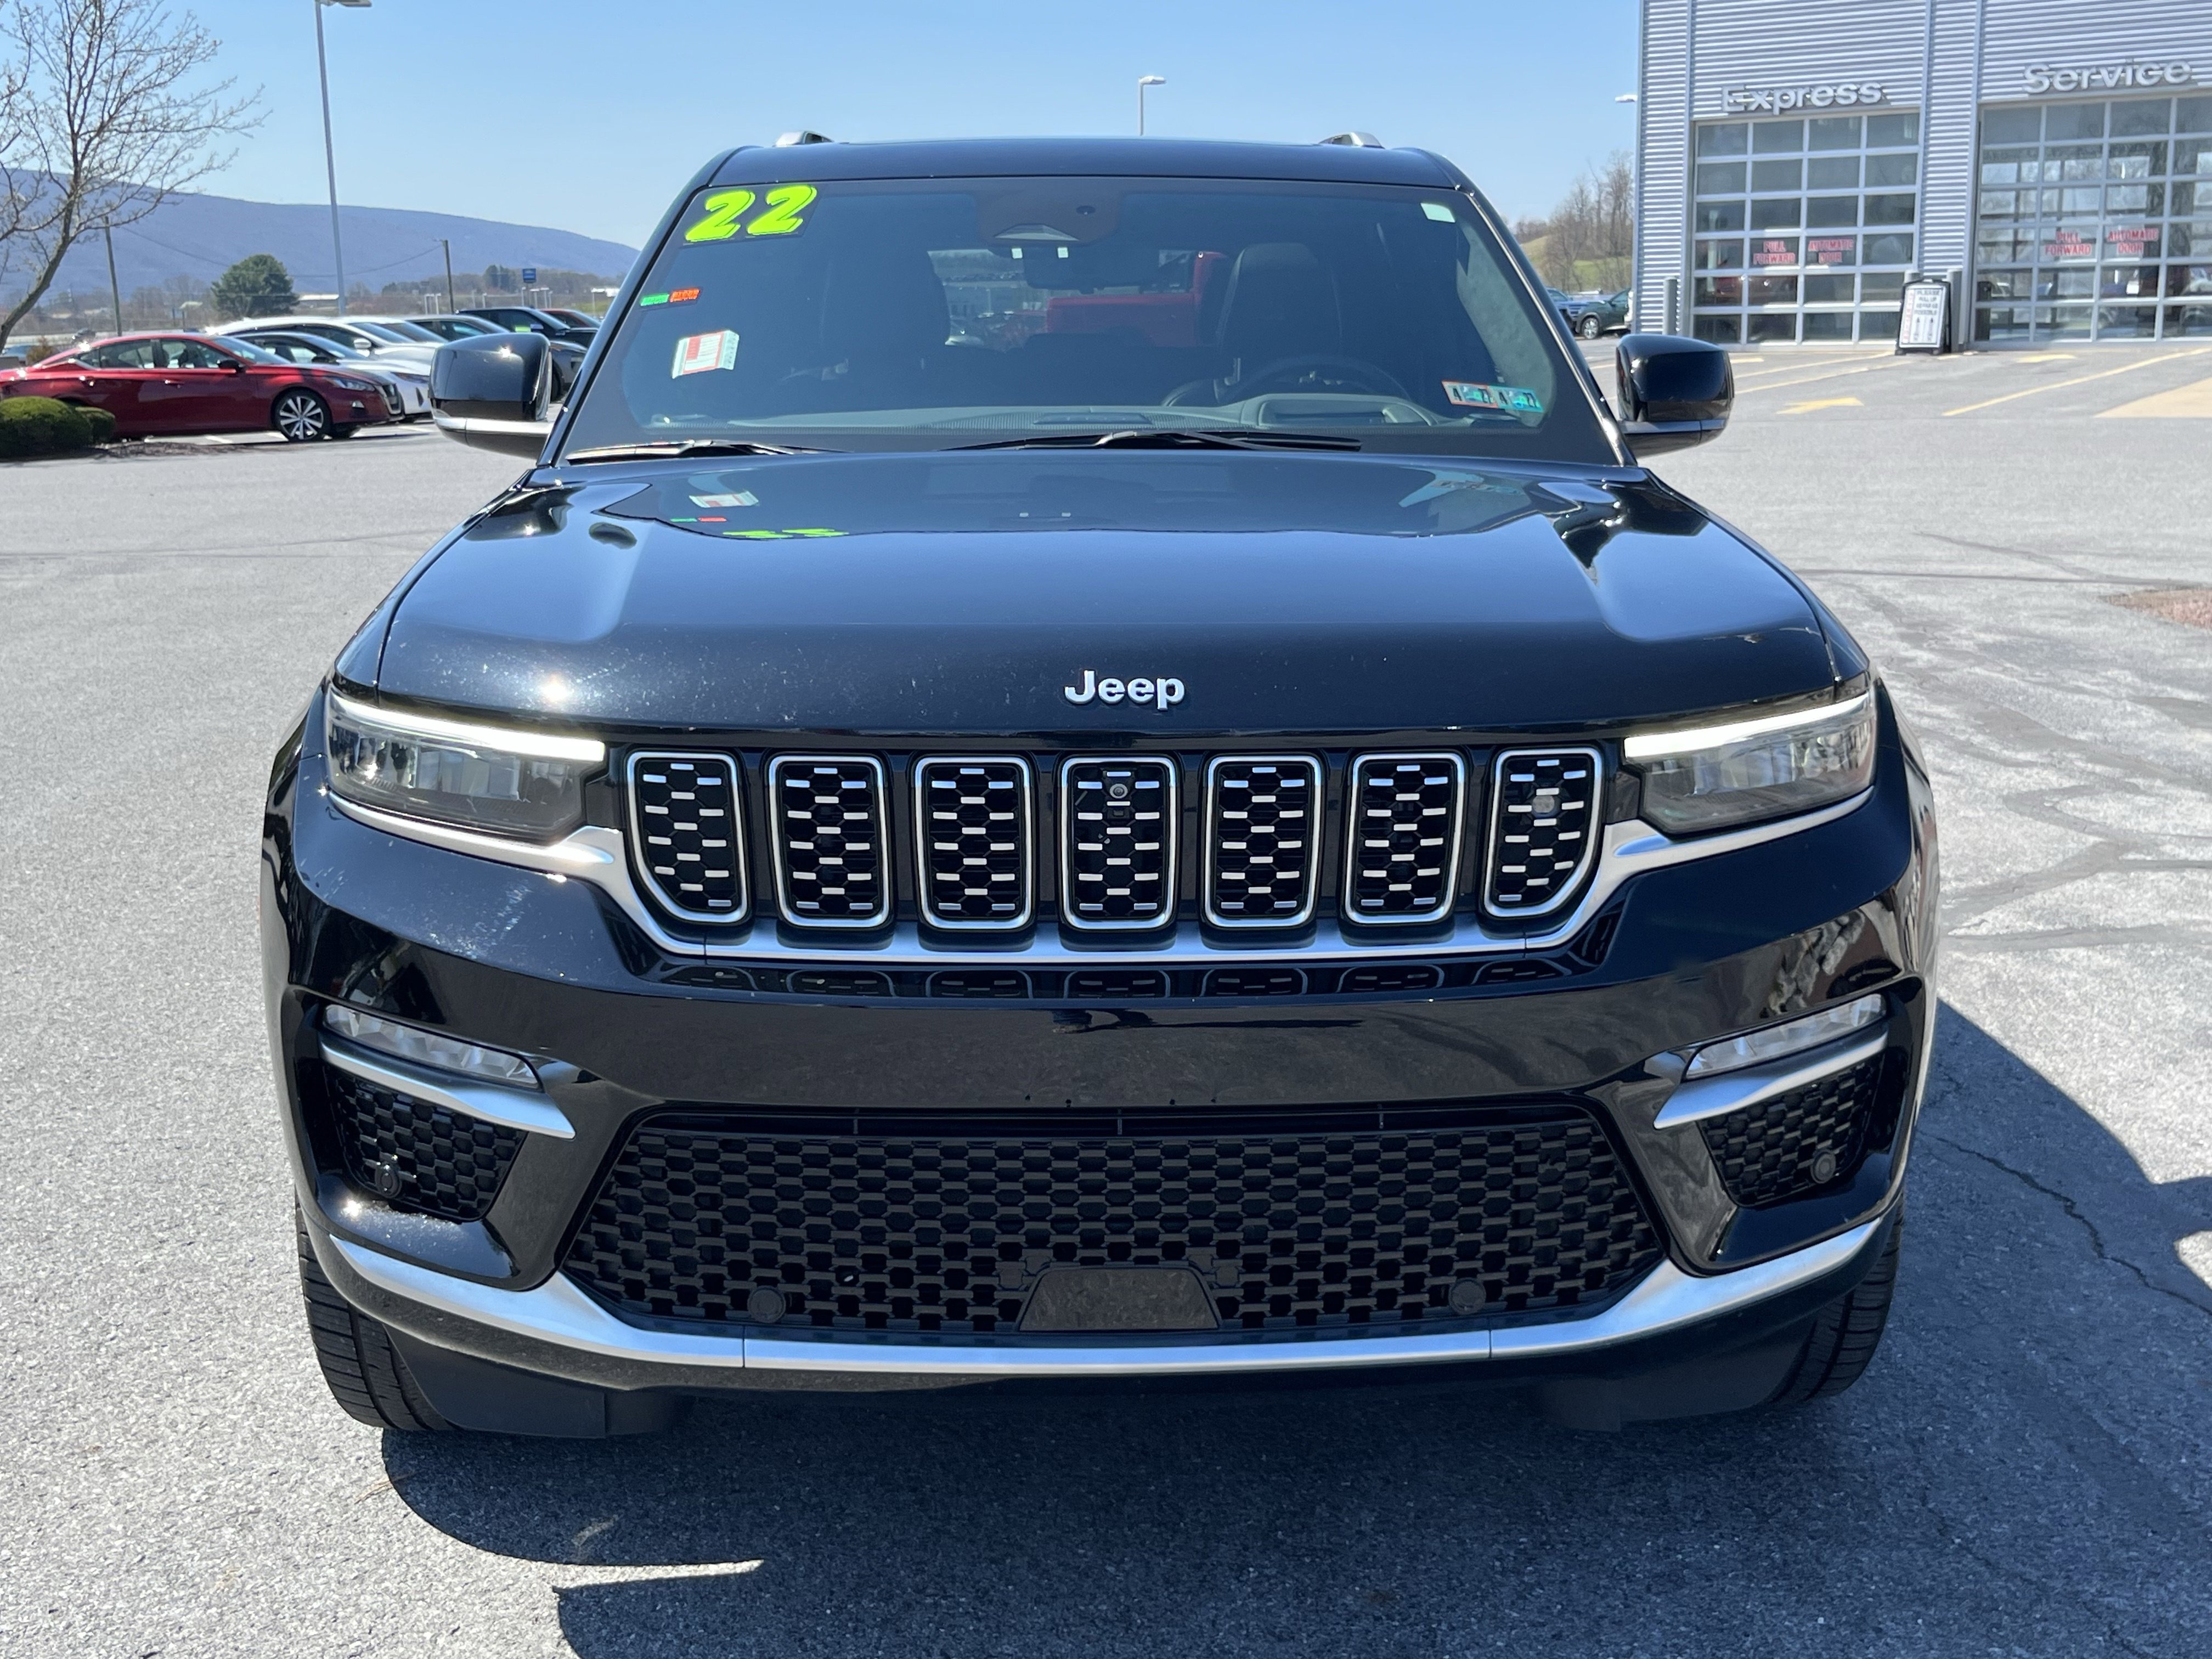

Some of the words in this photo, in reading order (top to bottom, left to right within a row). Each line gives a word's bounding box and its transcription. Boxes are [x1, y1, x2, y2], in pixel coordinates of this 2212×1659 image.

[1722, 82, 1883, 115] Express
[2022, 58, 2192, 94] Service
[685, 185, 817, 242] 22
[2056, 230, 2081, 244] PULL
[2107, 228, 2159, 242] AUTOMATIC
[2045, 244, 2092, 256] FORWARD
[2117, 242, 2144, 256] DOOR
[1753, 252, 1796, 265] FORWARD
[1064, 670, 1185, 711] Jeep
